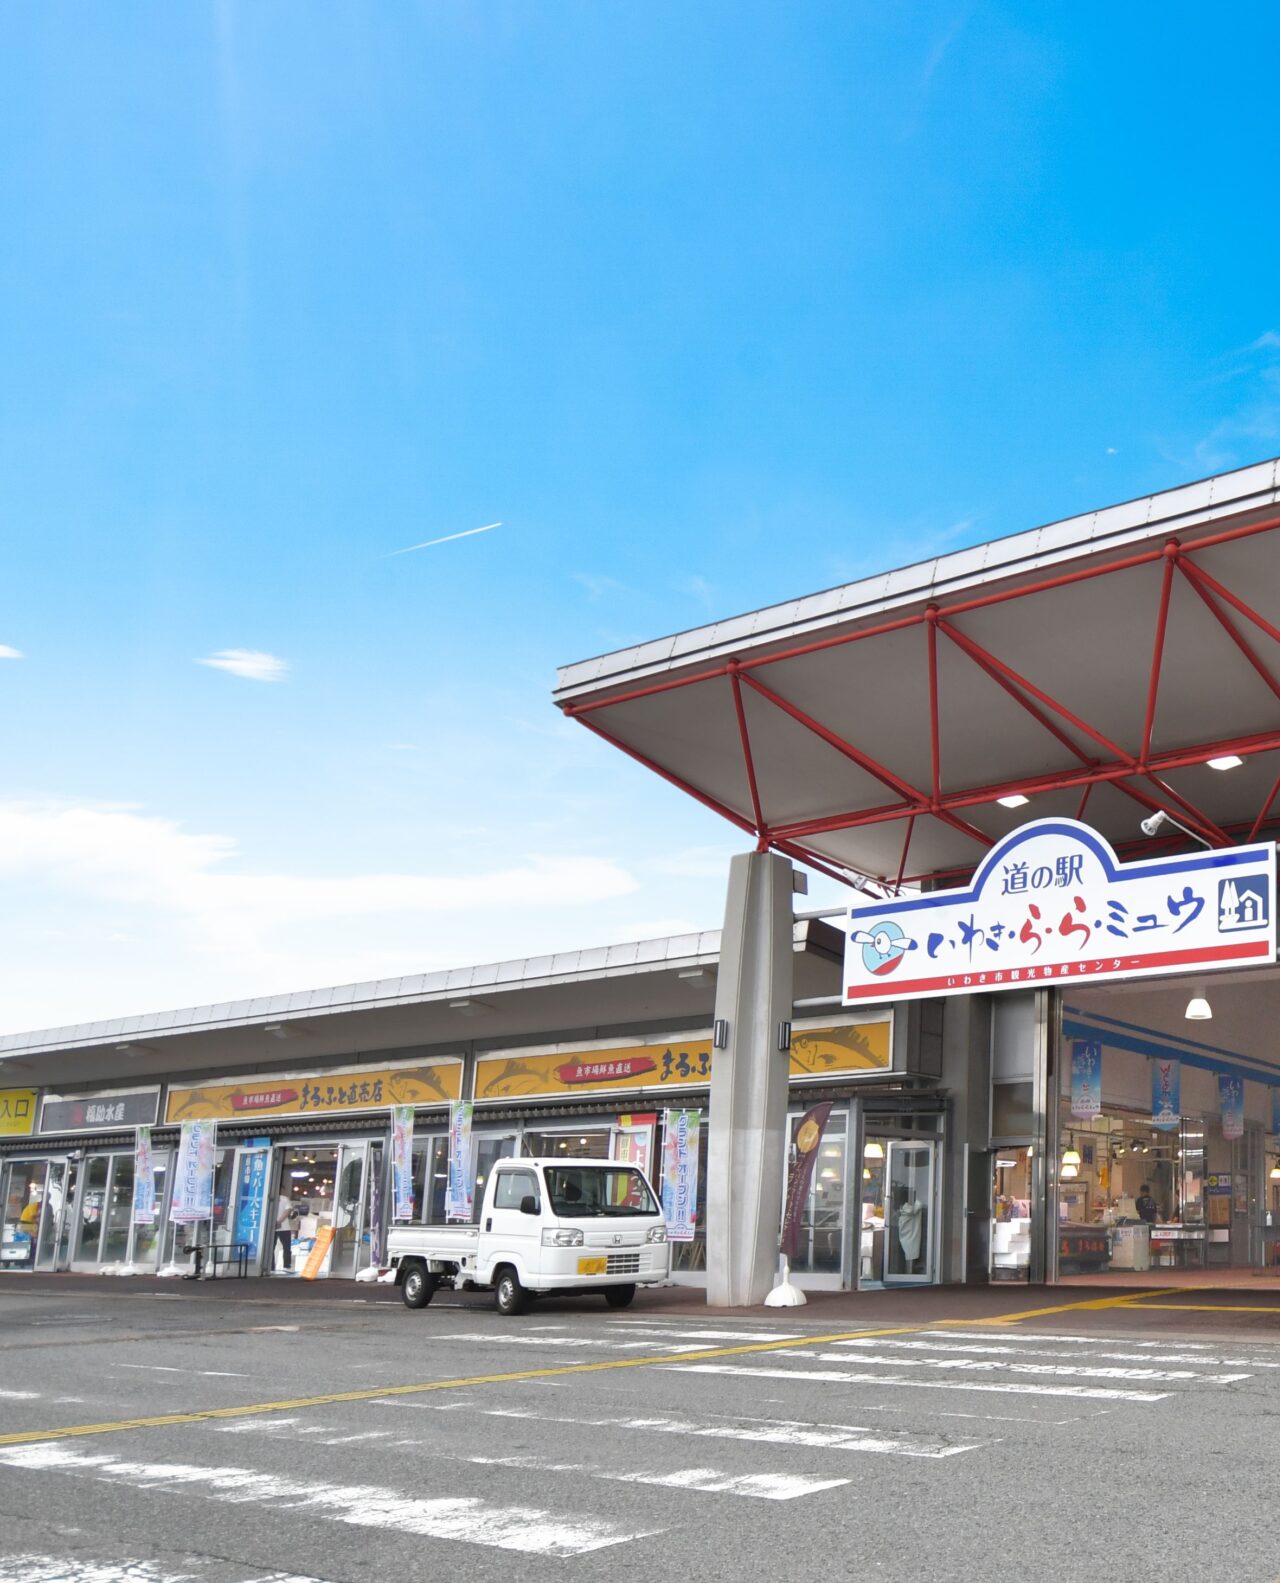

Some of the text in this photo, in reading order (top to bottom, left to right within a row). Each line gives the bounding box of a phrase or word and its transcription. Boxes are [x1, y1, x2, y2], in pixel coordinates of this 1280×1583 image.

[1001, 854, 1084, 896] 道の駅
[927, 886, 1205, 964] いわき・ら・ら・ミュウ
[947, 959, 1140, 986] いわき市観光物産センター
